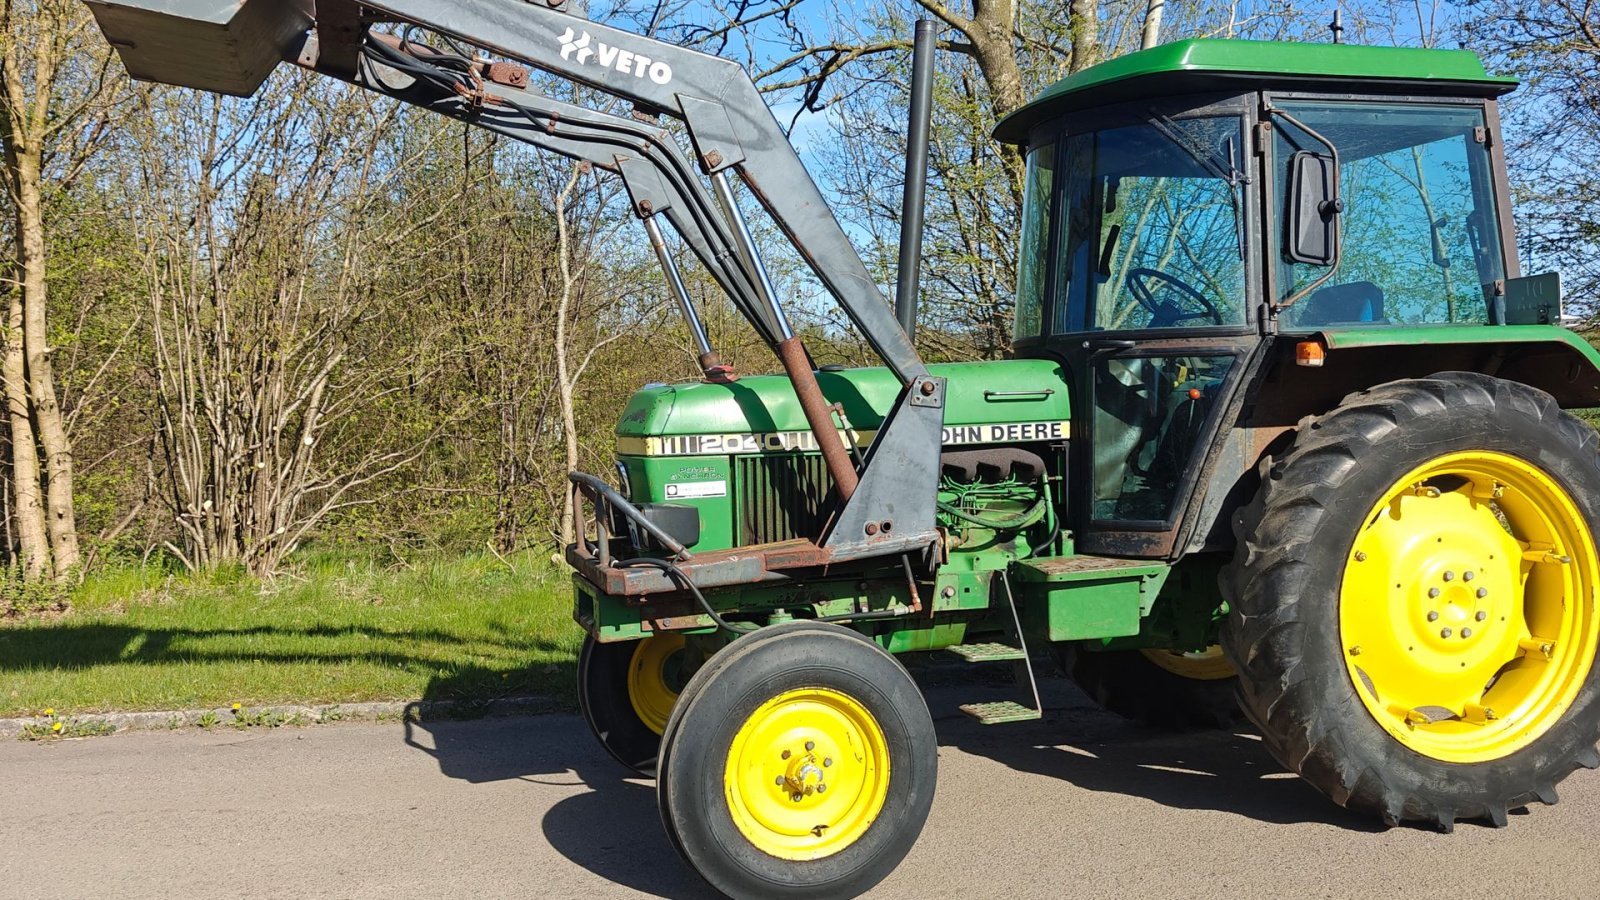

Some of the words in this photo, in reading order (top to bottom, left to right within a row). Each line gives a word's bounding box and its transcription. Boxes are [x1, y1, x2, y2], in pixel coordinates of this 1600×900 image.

[598, 42, 672, 85] VETO
[701, 432, 785, 453] 2040
[941, 426, 982, 444] OHN
[991, 422, 1062, 441] DEERE
